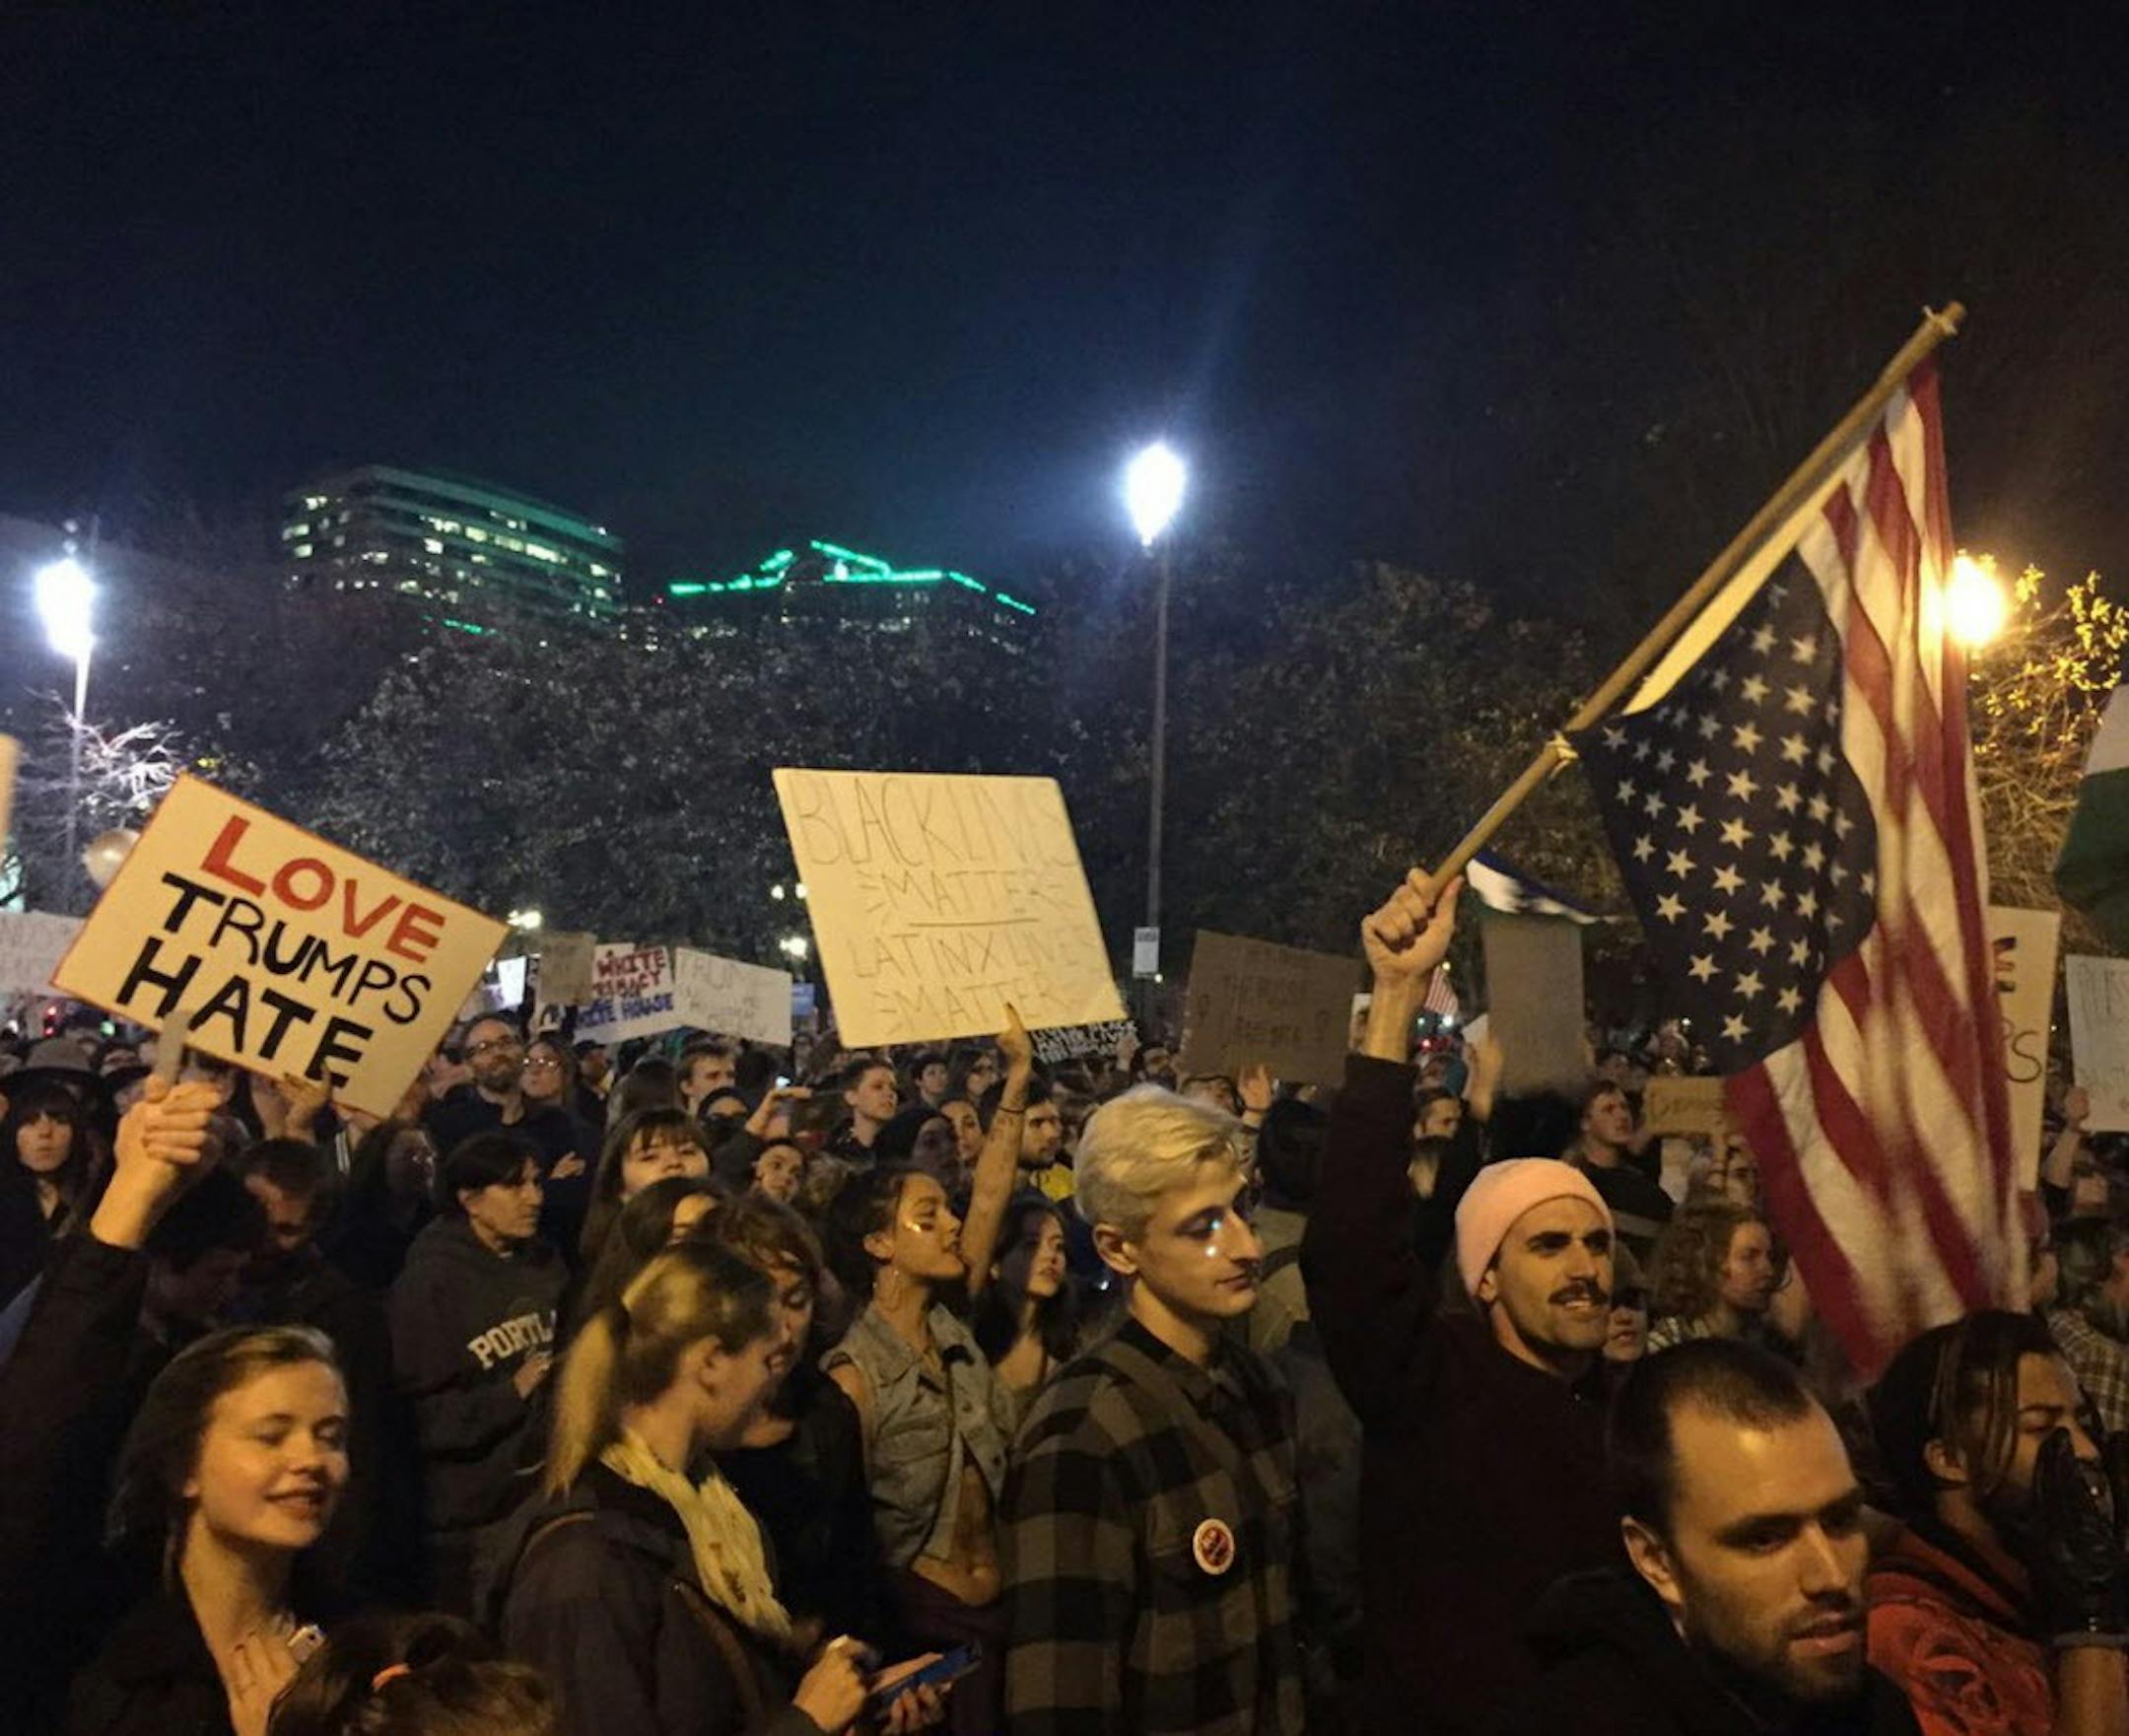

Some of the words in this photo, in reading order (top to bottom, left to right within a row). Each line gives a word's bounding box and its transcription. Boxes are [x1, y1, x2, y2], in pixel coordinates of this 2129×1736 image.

[790, 775, 962, 868] BLACK
[200, 815, 446, 963] LOVE
[881, 869, 1073, 918] MATTER
[162, 871, 432, 1024] TRUMPS
[846, 930, 1003, 979] LATINX
[115, 937, 373, 1088] HATE
[893, 971, 1068, 1032] MATTER
